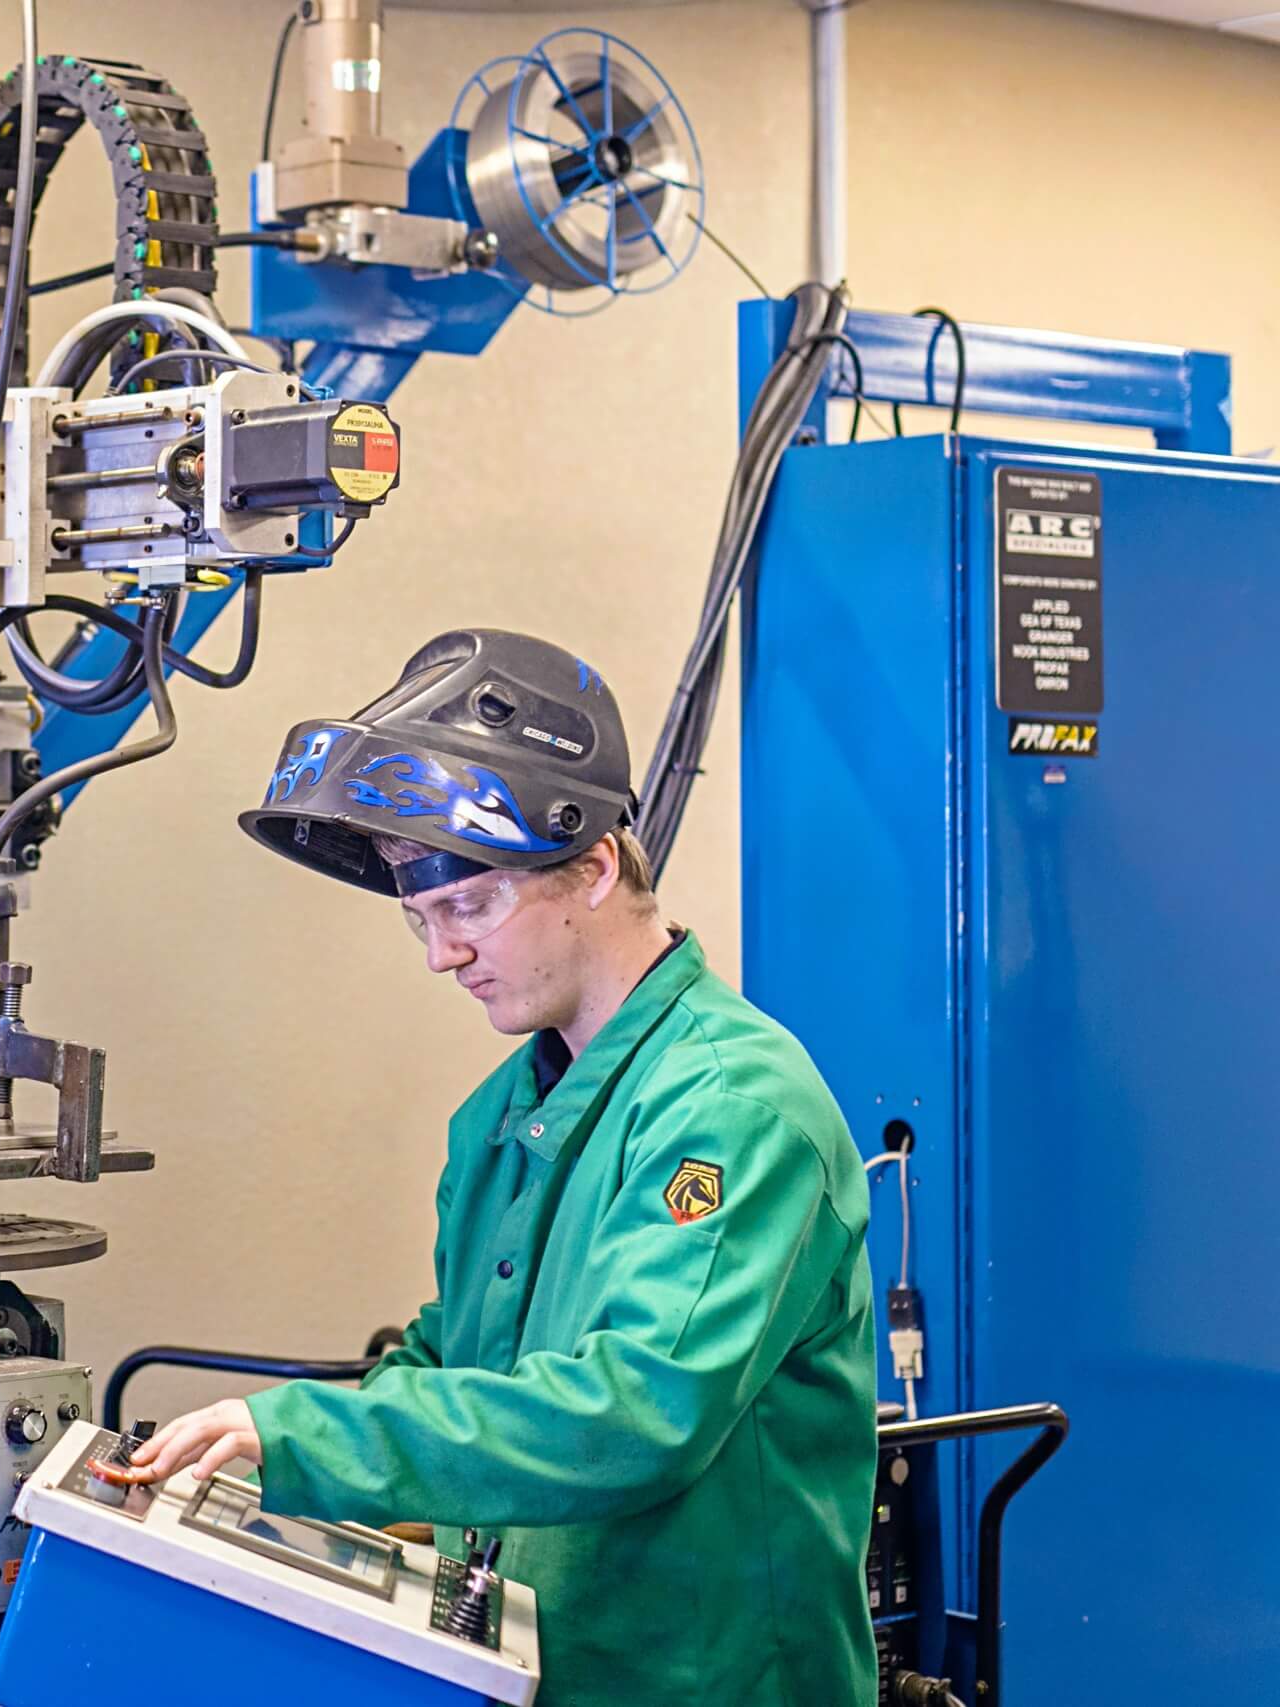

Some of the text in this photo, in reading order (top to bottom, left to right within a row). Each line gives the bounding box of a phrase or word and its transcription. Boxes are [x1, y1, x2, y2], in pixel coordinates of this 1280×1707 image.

[333, 434, 358, 443] VEXTA
[1009, 514, 1090, 538] ARC
[1010, 722, 1097, 752] PROFAX
